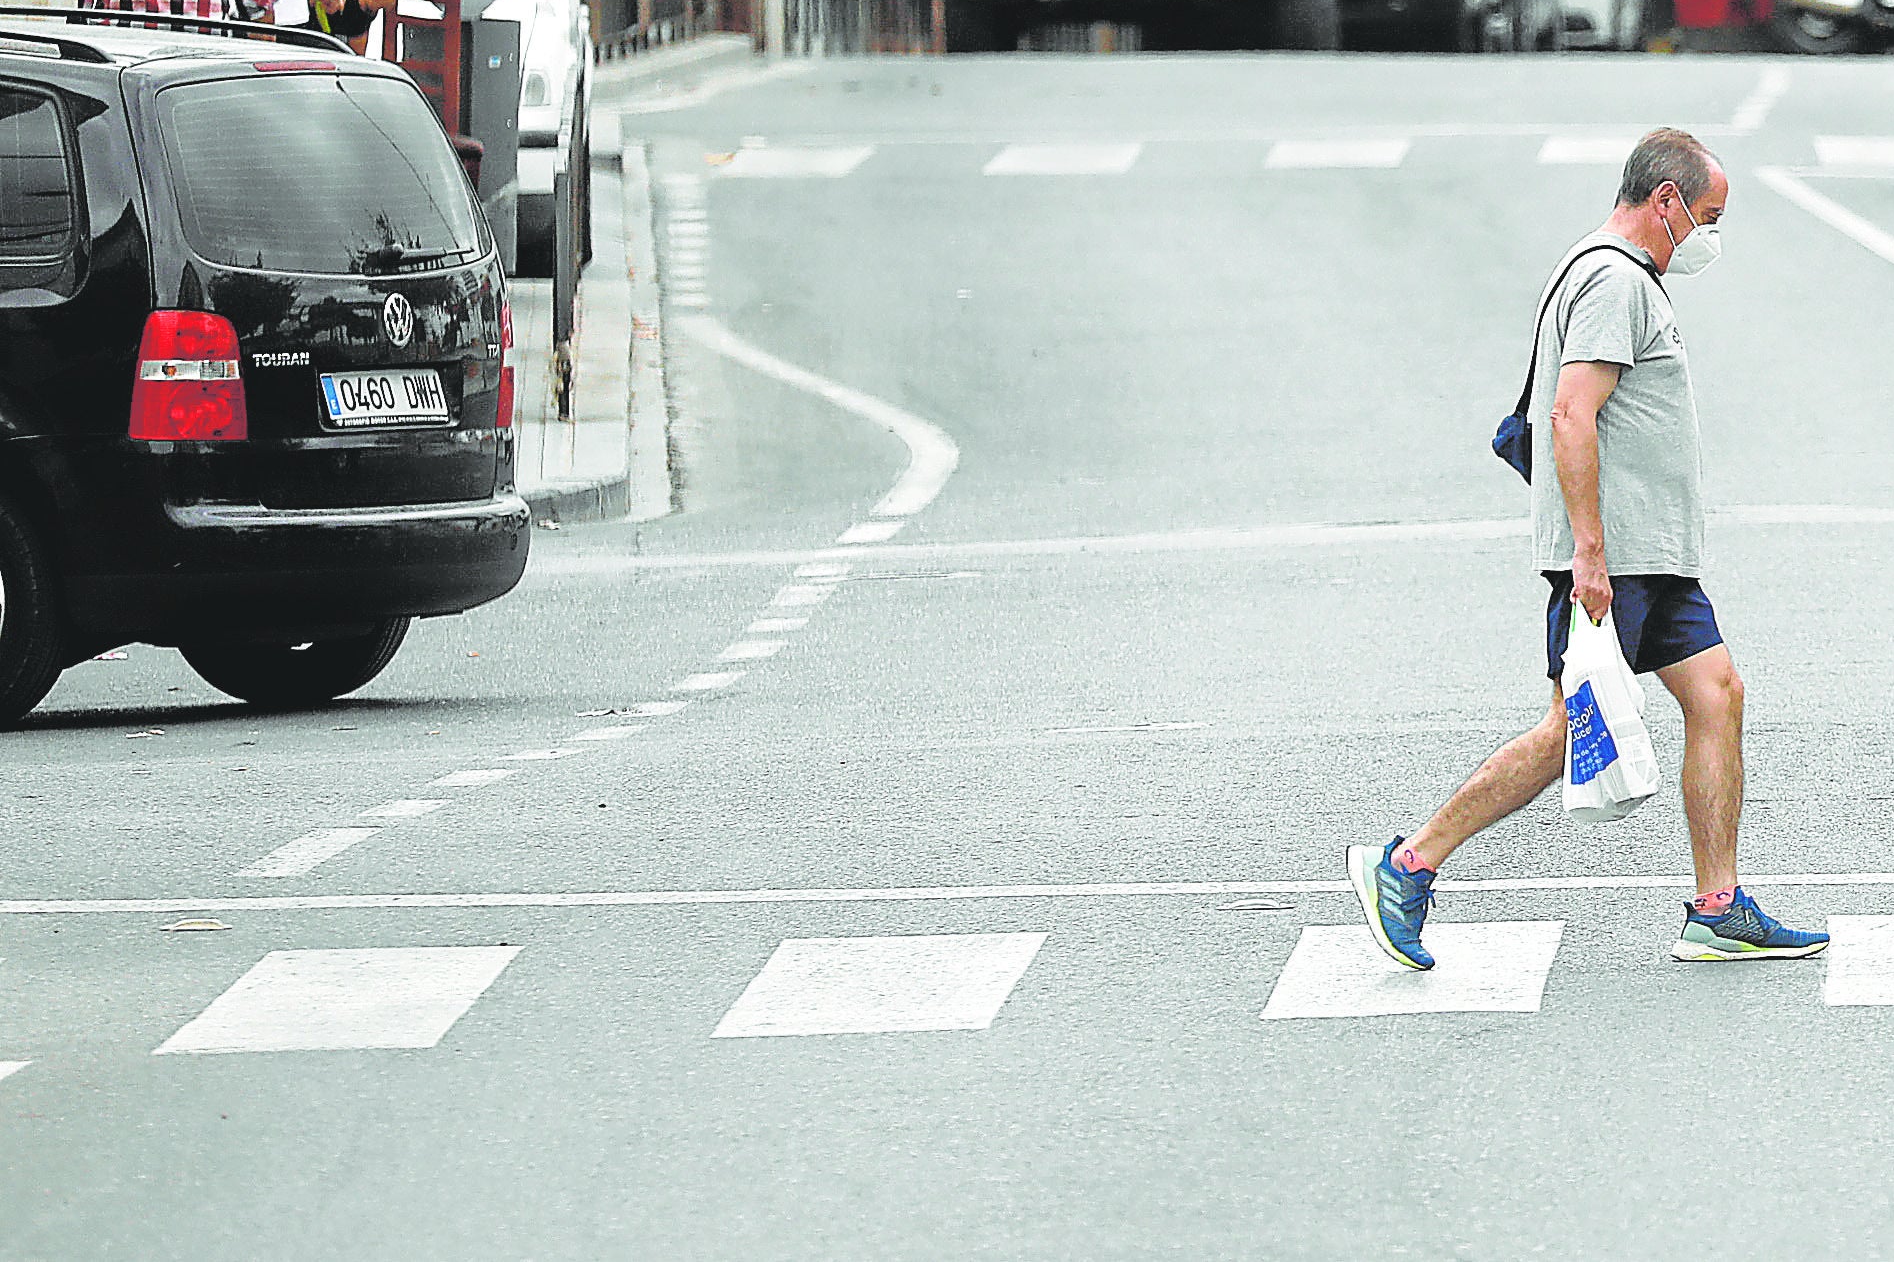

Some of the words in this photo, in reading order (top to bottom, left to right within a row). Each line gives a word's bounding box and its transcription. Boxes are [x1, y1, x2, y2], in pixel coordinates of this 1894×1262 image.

[253, 351, 310, 368] TOURAN
[339, 377, 395, 412] 0460
[402, 374, 444, 409] DWH
